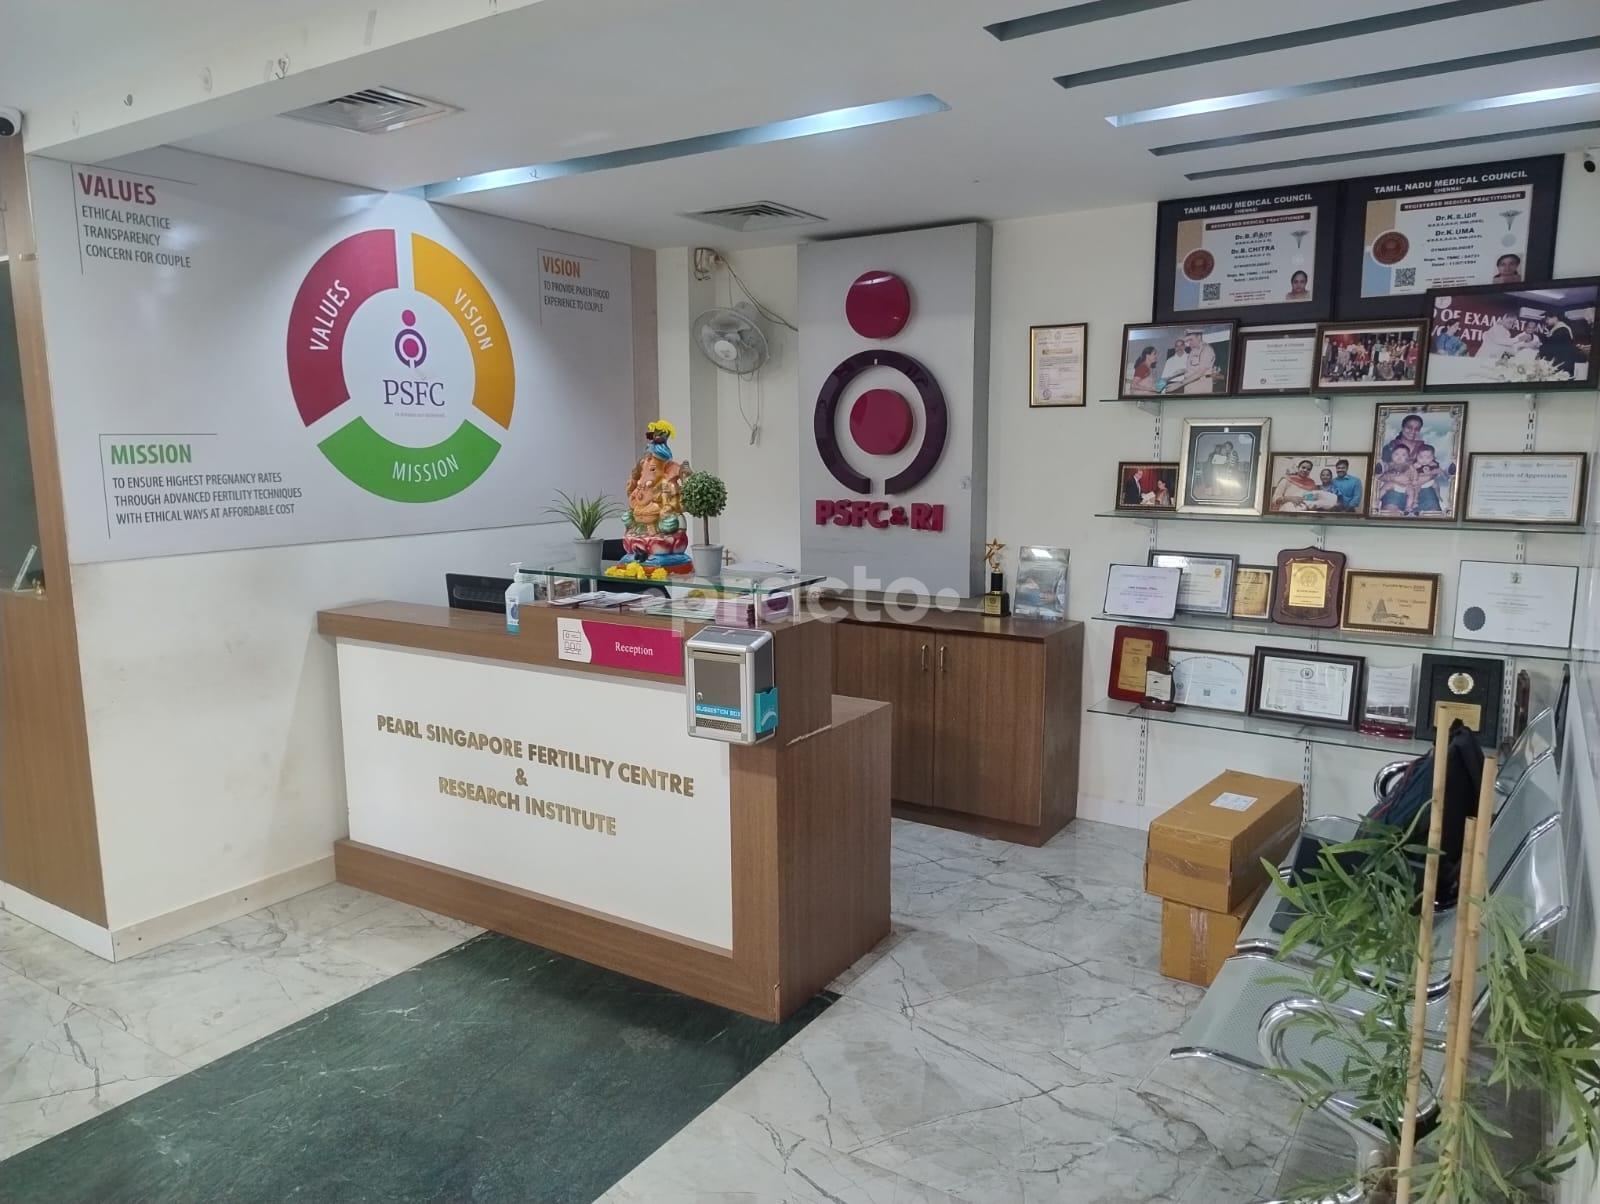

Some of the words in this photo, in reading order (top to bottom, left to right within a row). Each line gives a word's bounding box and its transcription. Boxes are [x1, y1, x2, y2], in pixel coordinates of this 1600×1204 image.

[78, 172, 156, 205] VALUES
[1374, 185, 1402, 194] TAMIL
[1404, 181, 1432, 190] NADU
[1434, 175, 1479, 187] MEDICAL
[1481, 170, 1528, 182] COUNCIL
[1183, 205, 1208, 215] TAMIL
[1209, 202, 1233, 211] NADU
[1234, 199, 1272, 209] MEDICAL
[1273, 193, 1313, 204] COUNCIL
[82, 205, 124, 223] ETHICAL
[126, 211, 171, 230] PRACTICE
[83, 224, 161, 247] TRANSPARENCY
[85, 243, 133, 261] CONCERN
[135, 250, 154, 264] FOR
[155, 252, 192, 269] COUPLE
[543, 255, 581, 278] VISION
[309, 279, 351, 351] VALUES
[453, 287, 494, 351] VISION
[1440, 308, 1461, 322] OF
[382, 379, 445, 407] PSFC
[110, 443, 193, 465] MISSION
[112, 477, 126, 489] TO
[127, 475, 164, 489] ENSURE
[165, 474, 204, 488] HIGHEST
[205, 472, 256, 486] PREGNANCY
[257, 472, 282, 483] RATES
[392, 454, 460, 483] MISSION
[114, 494, 161, 507] THROUGH
[163, 491, 211, 506] ADVANCED
[212, 489, 252, 502] FERTILITY
[253, 487, 302, 500] TECHNIQUES
[116, 512, 142, 525] WITH
[144, 509, 182, 524] ETHICAL
[184, 508, 209, 520] WAYS
[210, 508, 221, 519] AT
[222, 505, 275, 519] AFFORDABLE
[275, 503, 295, 515] COST
[815, 499, 890, 530] PSFC
[910, 502, 945, 533] RI
[614, 641, 654, 656] Reception
[377, 714, 423, 739] PEARL
[426, 723, 523, 760] SINGAPORE
[527, 743, 615, 779] FERTILITY
[617, 762, 695, 799] CENTRE
[514, 767, 528, 787] &
[438, 776, 520, 812] RESEARCH
[525, 795, 617, 836] INSTITUTE
